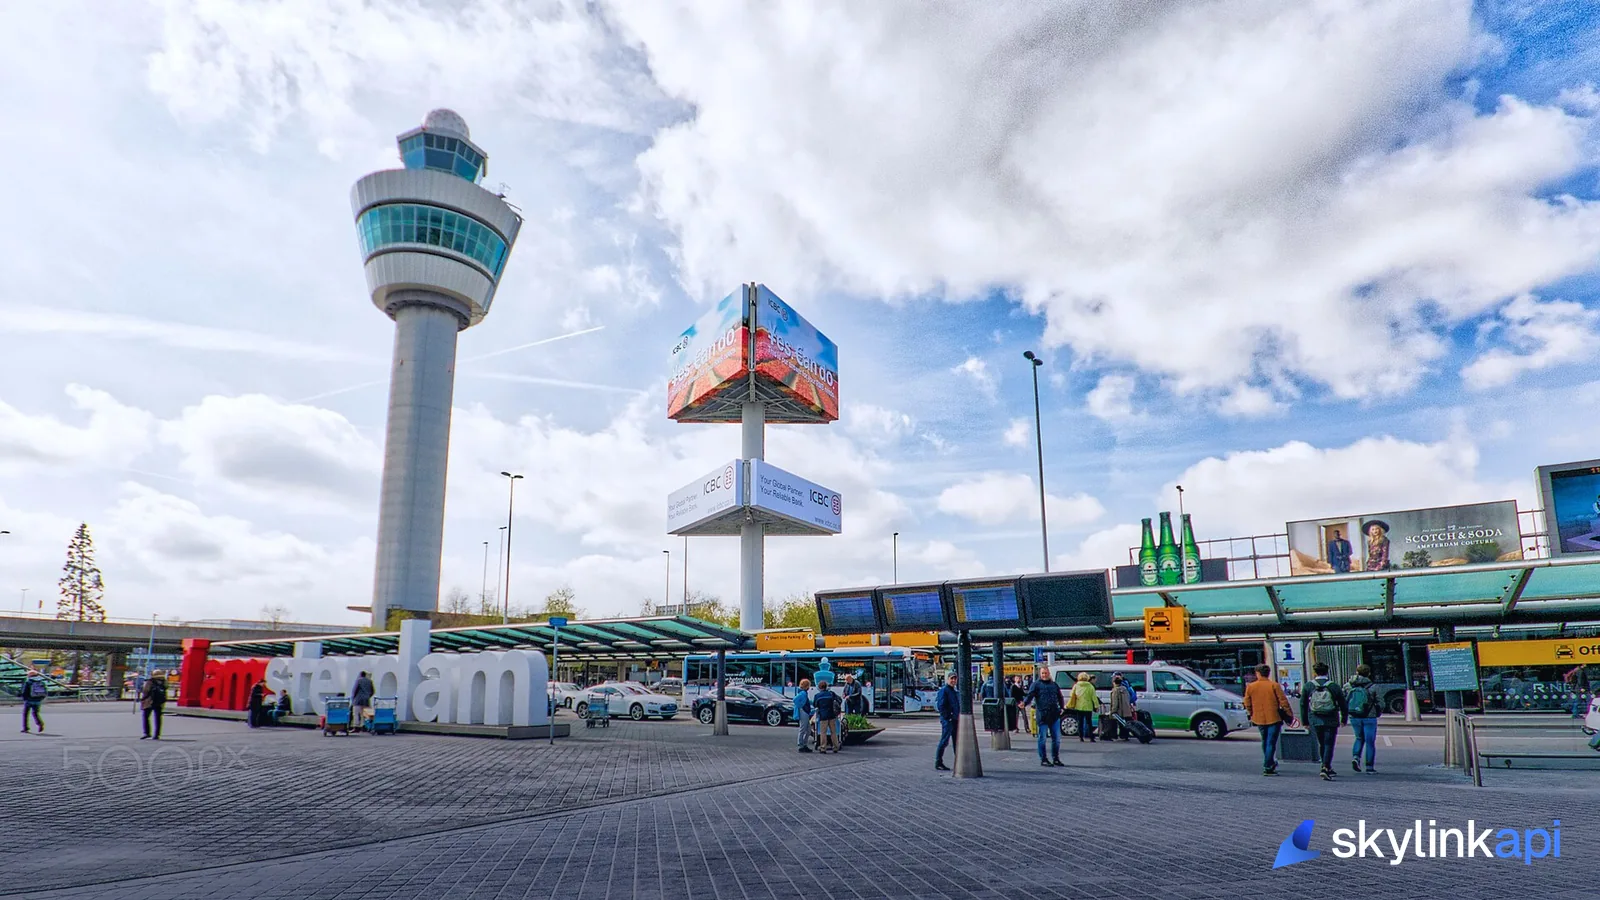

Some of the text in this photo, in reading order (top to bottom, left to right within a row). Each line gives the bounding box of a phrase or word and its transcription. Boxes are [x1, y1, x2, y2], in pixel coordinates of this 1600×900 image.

[703, 476, 721, 495] ICBC
[760, 475, 772, 485] Your
[772, 479, 787, 491] Global
[760, 485, 772, 496] Your
[773, 489, 791, 502] Reliable
[809, 489, 829, 508] ICBC
[1405, 532, 1456, 544] SCOTCH
[1468, 528, 1503, 539] SODA
[1417, 541, 1459, 549] AMSTERDAM
